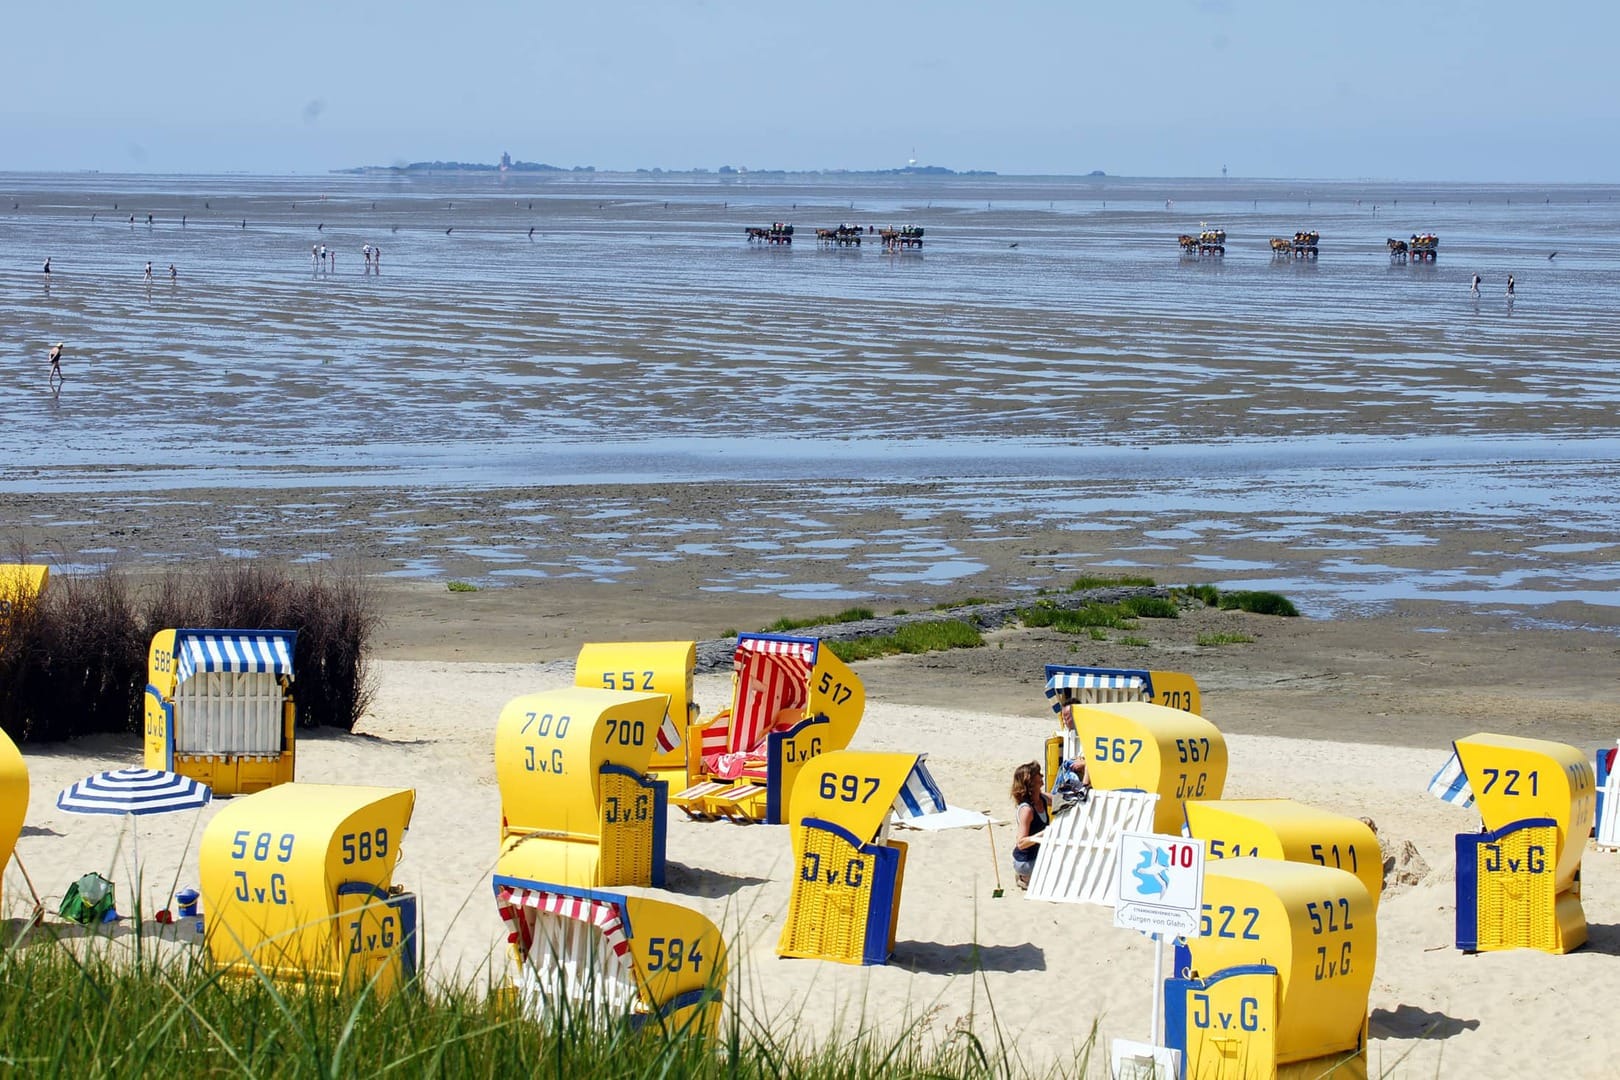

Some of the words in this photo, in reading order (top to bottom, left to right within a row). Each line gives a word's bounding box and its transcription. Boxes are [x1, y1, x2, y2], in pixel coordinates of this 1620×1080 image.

[154, 648, 171, 673] 588
[603, 671, 655, 690] 552
[819, 671, 853, 706] 517
[520, 712, 571, 739] 700
[606, 720, 645, 746] 700
[1094, 737, 1143, 764] 567
[1175, 737, 1210, 763] 567
[819, 772, 880, 804] 697
[1482, 768, 1539, 797] 721
[231, 830, 295, 863] 589
[342, 827, 389, 865] 589
[1169, 844, 1193, 867] 10
[1306, 897, 1353, 935] 522
[647, 937, 703, 973] 594
